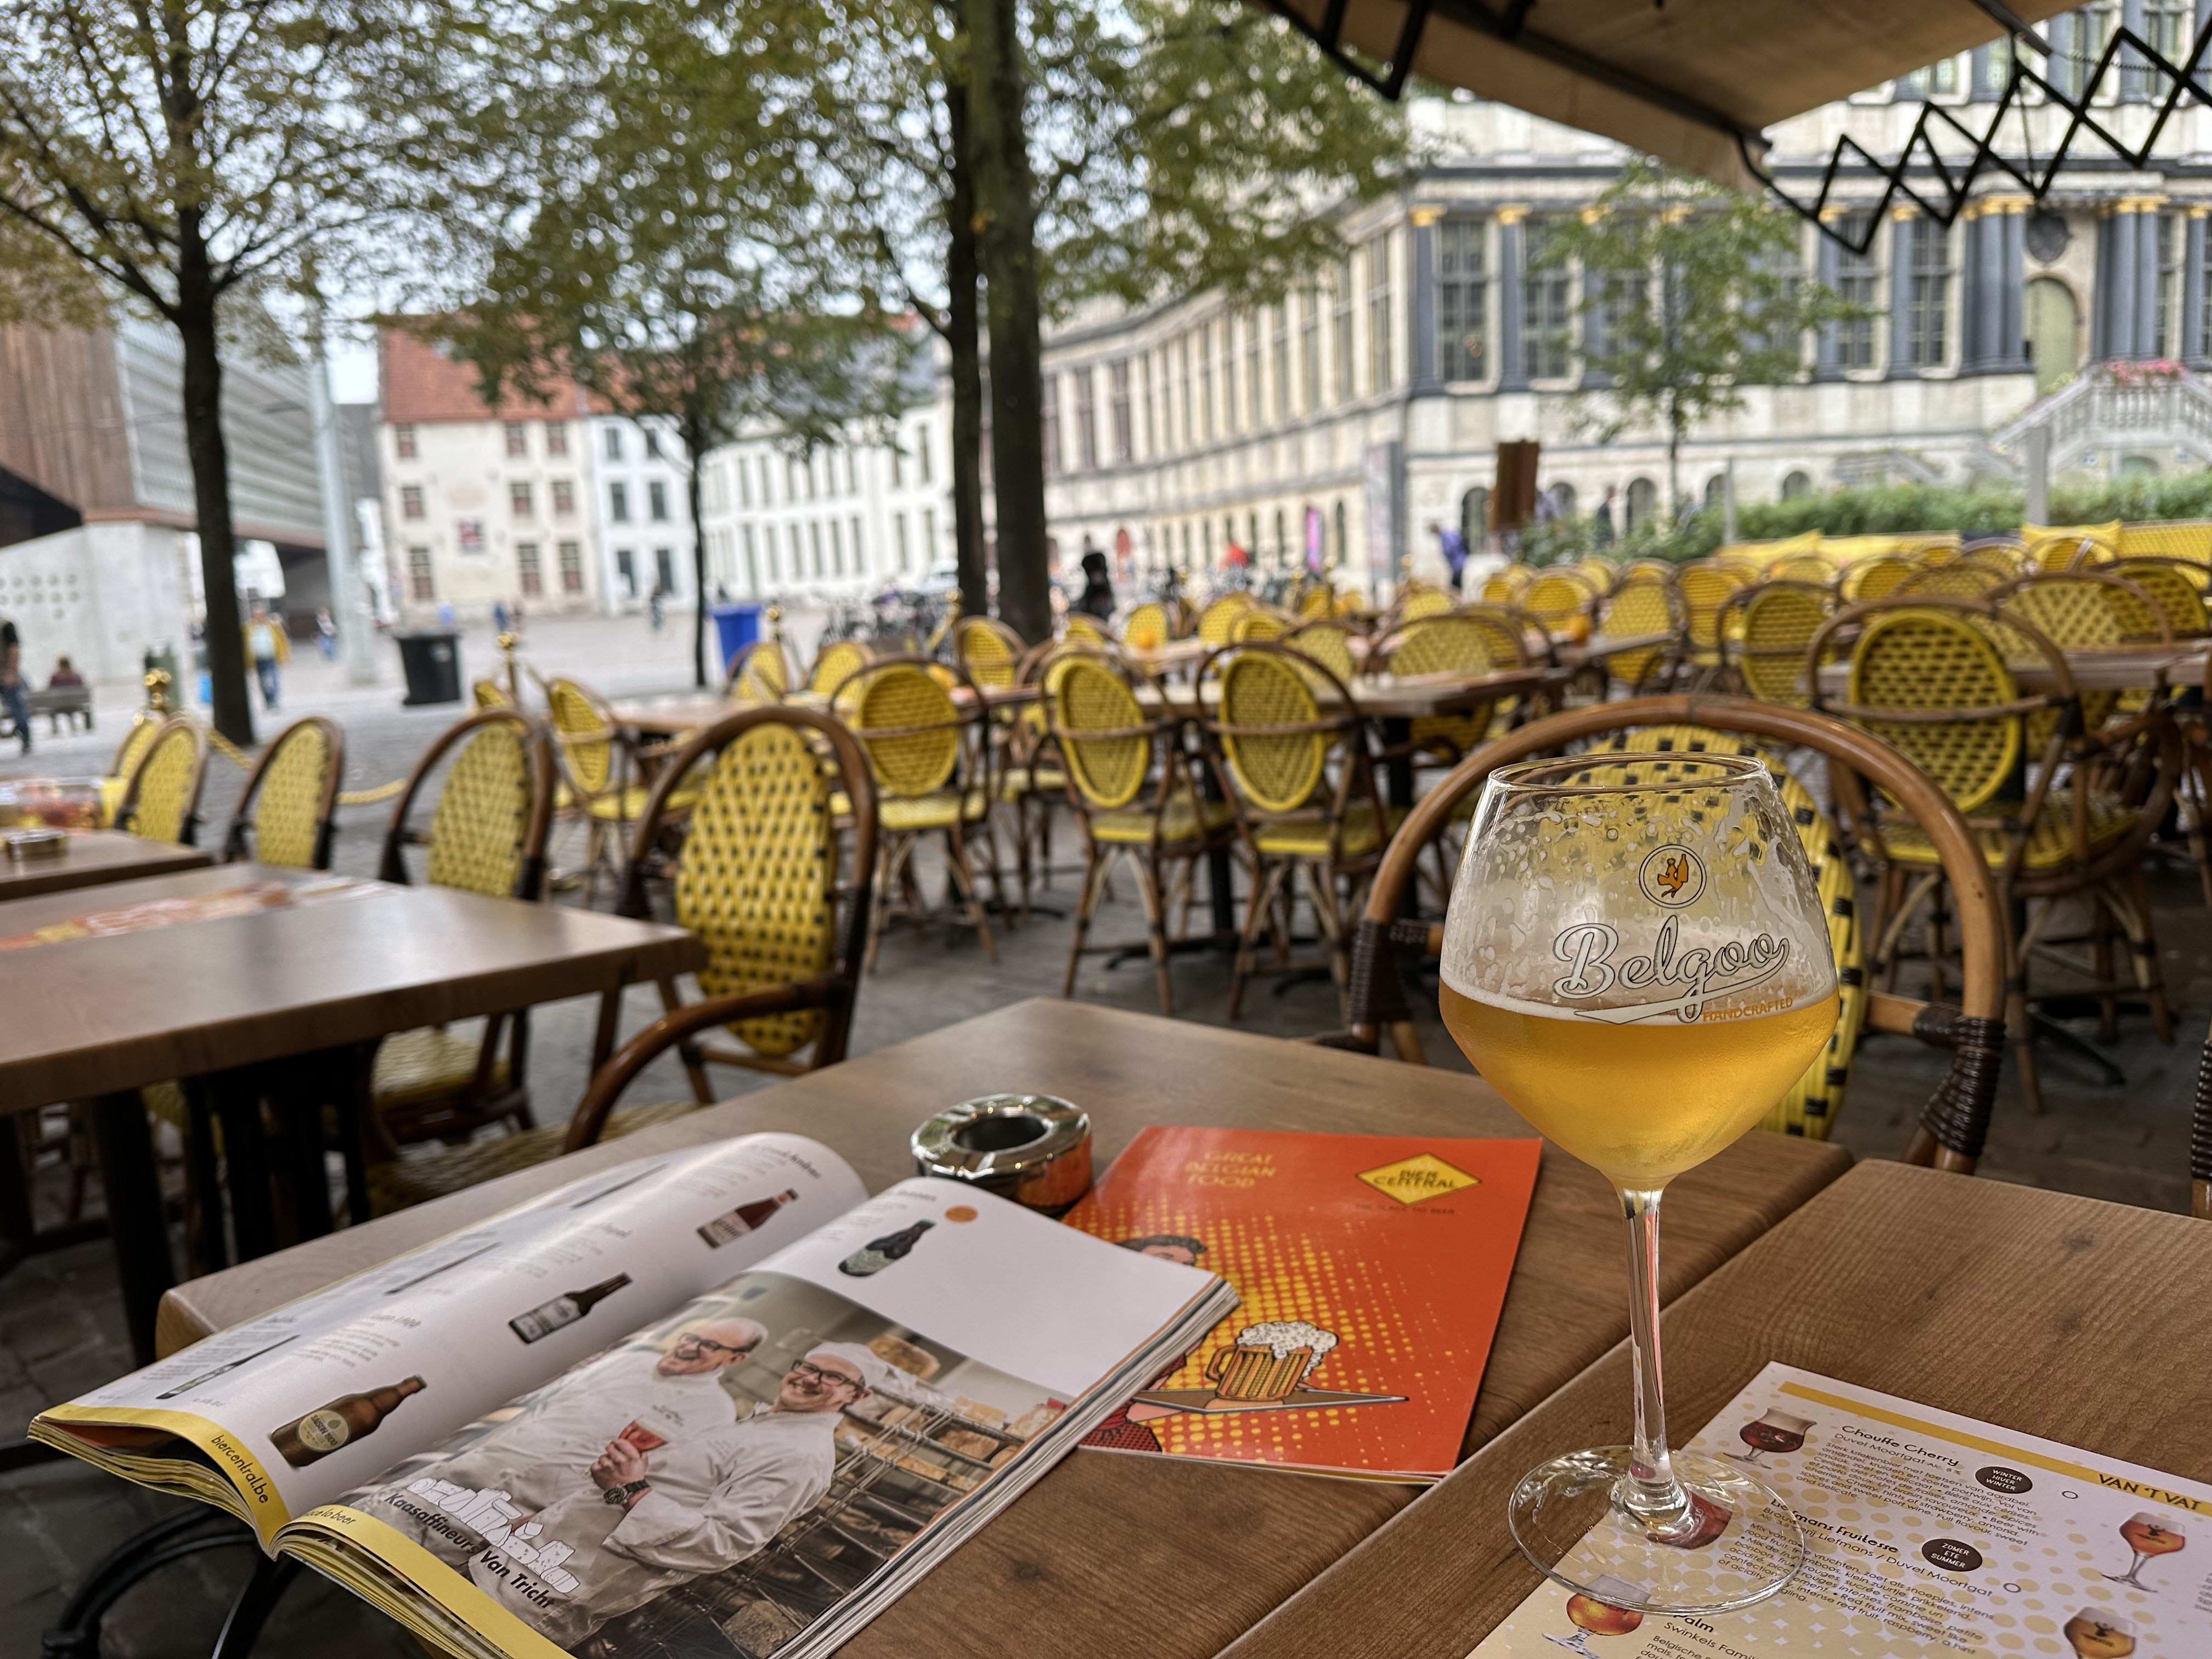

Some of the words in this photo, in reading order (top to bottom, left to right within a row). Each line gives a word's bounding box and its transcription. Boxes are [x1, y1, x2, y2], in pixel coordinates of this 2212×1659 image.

[1553, 915, 1790, 1024] Belgoo
[1702, 996, 1794, 1022] HANDCRAFTED
[1185, 1162, 1277, 1177] BELGIAN
[1188, 1173, 1256, 1188] FOOD
[1372, 1176, 1455, 1189] CENTRAL
[1826, 1442, 1848, 1452] Sterk
[1850, 1449, 1901, 1468] kriekenbier
[1925, 1472, 1962, 1486] toetsen
[1835, 1433, 1868, 1447] Duvel
[1869, 1444, 1926, 1464] Moortgat
[1842, 1426, 1900, 1447] Chouffe
[1904, 1444, 1959, 1468] Cherry
[211, 1435, 269, 1504] biercentral.be
[1853, 1463, 1874, 1471] zoet
[1944, 1491, 1971, 1500] Bière
[1985, 1478, 2016, 1491] WINTER
[1992, 1469, 2023, 1481] WINTER
[1992, 1475, 2016, 1485] HIVER
[1818, 1483, 1859, 1499] delicate.
[1819, 1465, 1847, 1475] porto
[1893, 1487, 1922, 1499] brasin
[1990, 1517, 2015, 1527] Beer
[2017, 1526, 2039, 1536] with
[1869, 1462, 1904, 1475] kruiden
[1921, 1478, 1949, 1488] zoete
[1999, 1500, 2015, 1508] Vol
[2017, 1506, 2036, 1515] van
[1870, 1474, 1897, 1485] notes
[2000, 1515, 2036, 1528] épices
[1882, 1490, 1905, 1500] hints
[2098, 1473, 2140, 1493] VAN
[2164, 1492, 2202, 1511] VAT
[330, 1509, 357, 1525] beer
[1800, 1471, 1830, 1482] spices
[1853, 1488, 1882, 1499] sweet
[1883, 1498, 1905, 1507] port
[1936, 1514, 1954, 1522] Full
[1995, 1533, 2028, 1545] sweet
[384, 1492, 479, 1554] Kaasaffineurs
[479, 1549, 511, 1578] Van
[510, 1573, 555, 1610] Tricht
[1745, 1530, 1770, 1540] rood
[1844, 1572, 1869, 1583] klein
[1836, 1526, 1898, 1553] Fruitesse
[1941, 1542, 1970, 1556] ZOMER
[1747, 1538, 1764, 1547] Mix
[1765, 1545, 1779, 1554] de
[1804, 1566, 1841, 1582] rouges,
[1844, 1581, 1881, 1595] sucrée
[1883, 1594, 1926, 1612] comme
[1750, 1523, 1767, 1532] Mix
[1769, 1530, 1786, 1541] van
[1813, 1554, 1861, 1574] vruchten,
[1863, 1571, 1888, 1582] zoet
[1960, 1604, 1994, 1620] intens
[1818, 1533, 1875, 1556] Liefmans
[1886, 1556, 1926, 1573] Duvel
[1927, 1571, 1993, 1596] Moortgat
[1931, 1553, 1966, 1568] SUMMER
[1797, 1585, 1835, 1603] intense
[1836, 1601, 1857, 1611] red
[1953, 1643, 1976, 1655] hint
[1801, 1572, 1839, 1588] rouges
[1838, 1585, 1883, 1605] intenses,
[1946, 1626, 1982, 1640] petite
[1840, 1594, 1863, 1605] Red
[1865, 1602, 1886, 1613] fruit
[1911, 1621, 1946, 1635] sweet
[1948, 1633, 1967, 1643] like
[1652, 1635, 1702, 1659] Belgische
[1663, 1621, 1716, 1649] Swinkels
